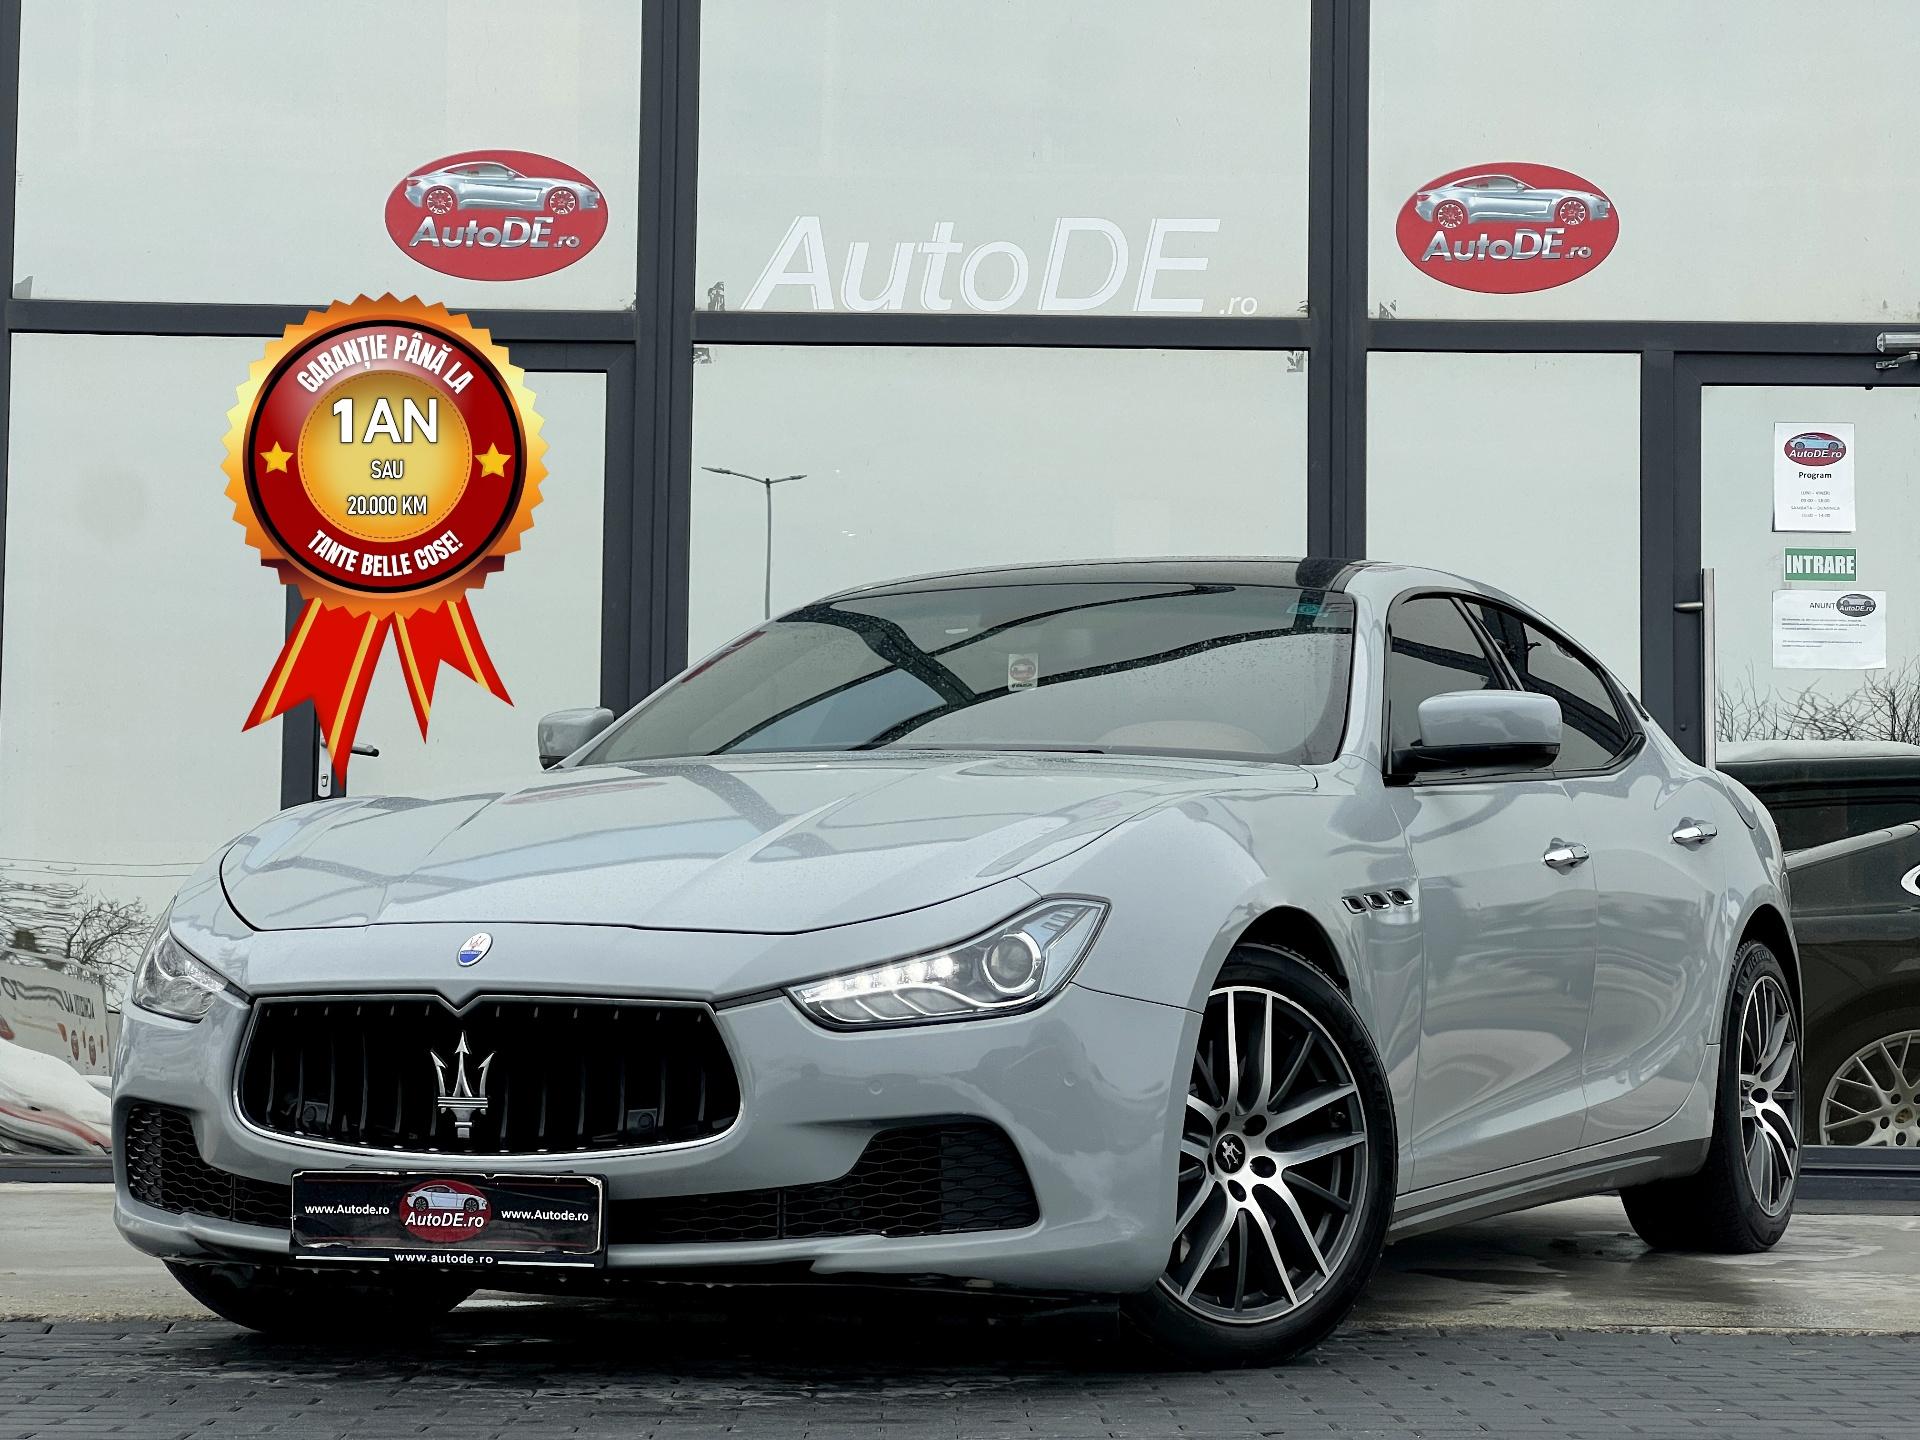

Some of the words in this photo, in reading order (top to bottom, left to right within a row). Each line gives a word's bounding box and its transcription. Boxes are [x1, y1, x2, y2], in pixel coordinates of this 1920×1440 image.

[1789, 449, 1842, 458] AutoDE.ro
[1798, 471, 1832, 481] Program
[1786, 555, 1855, 575] INTRARE
[304, 1203, 390, 1216] www.Autode.ro
[501, 1209, 589, 1222] www.Autode.ro
[405, 1211, 484, 1229] AutoDE.ro
[394, 1252, 494, 1265] www.autode.ro
